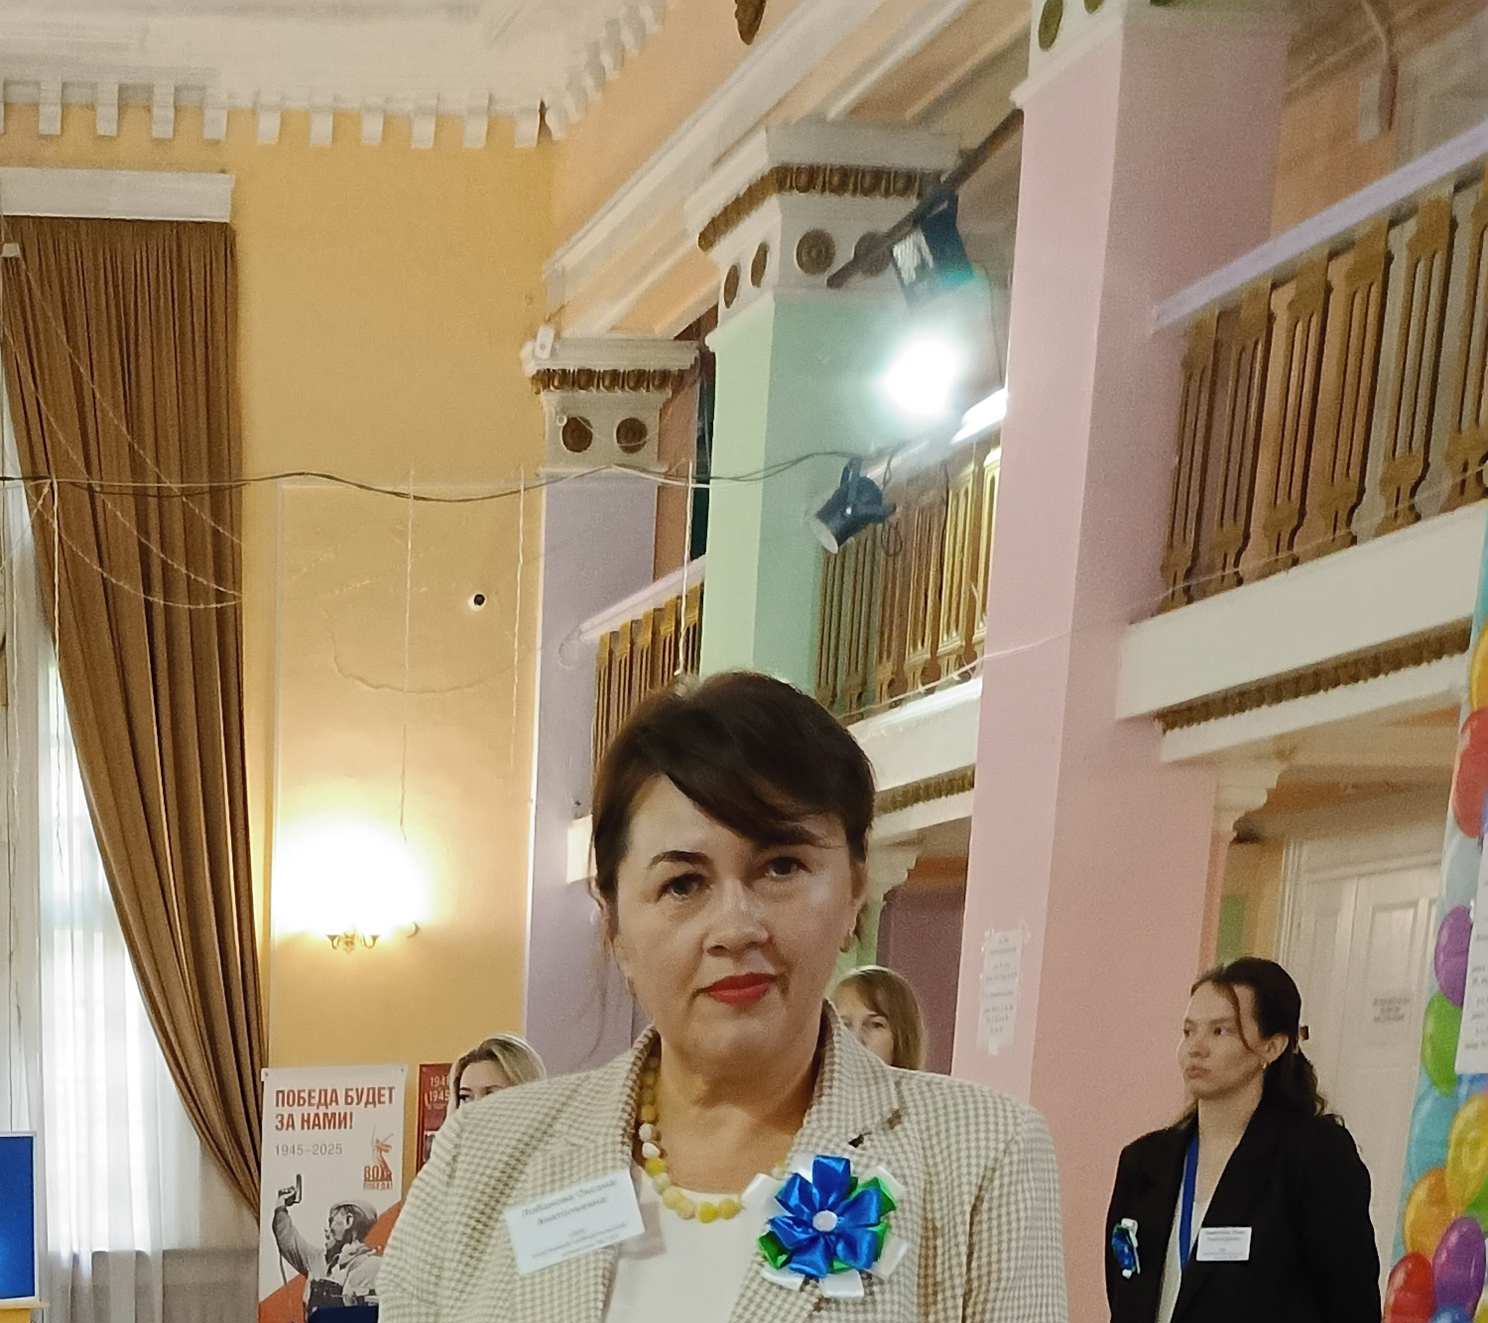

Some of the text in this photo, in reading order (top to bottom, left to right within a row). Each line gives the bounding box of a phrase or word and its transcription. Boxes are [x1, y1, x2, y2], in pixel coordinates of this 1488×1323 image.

[275, 1086, 396, 1109] ПОБЕДА БУДЕТ
[275, 1111, 354, 1131] ЗА НАМИ!
